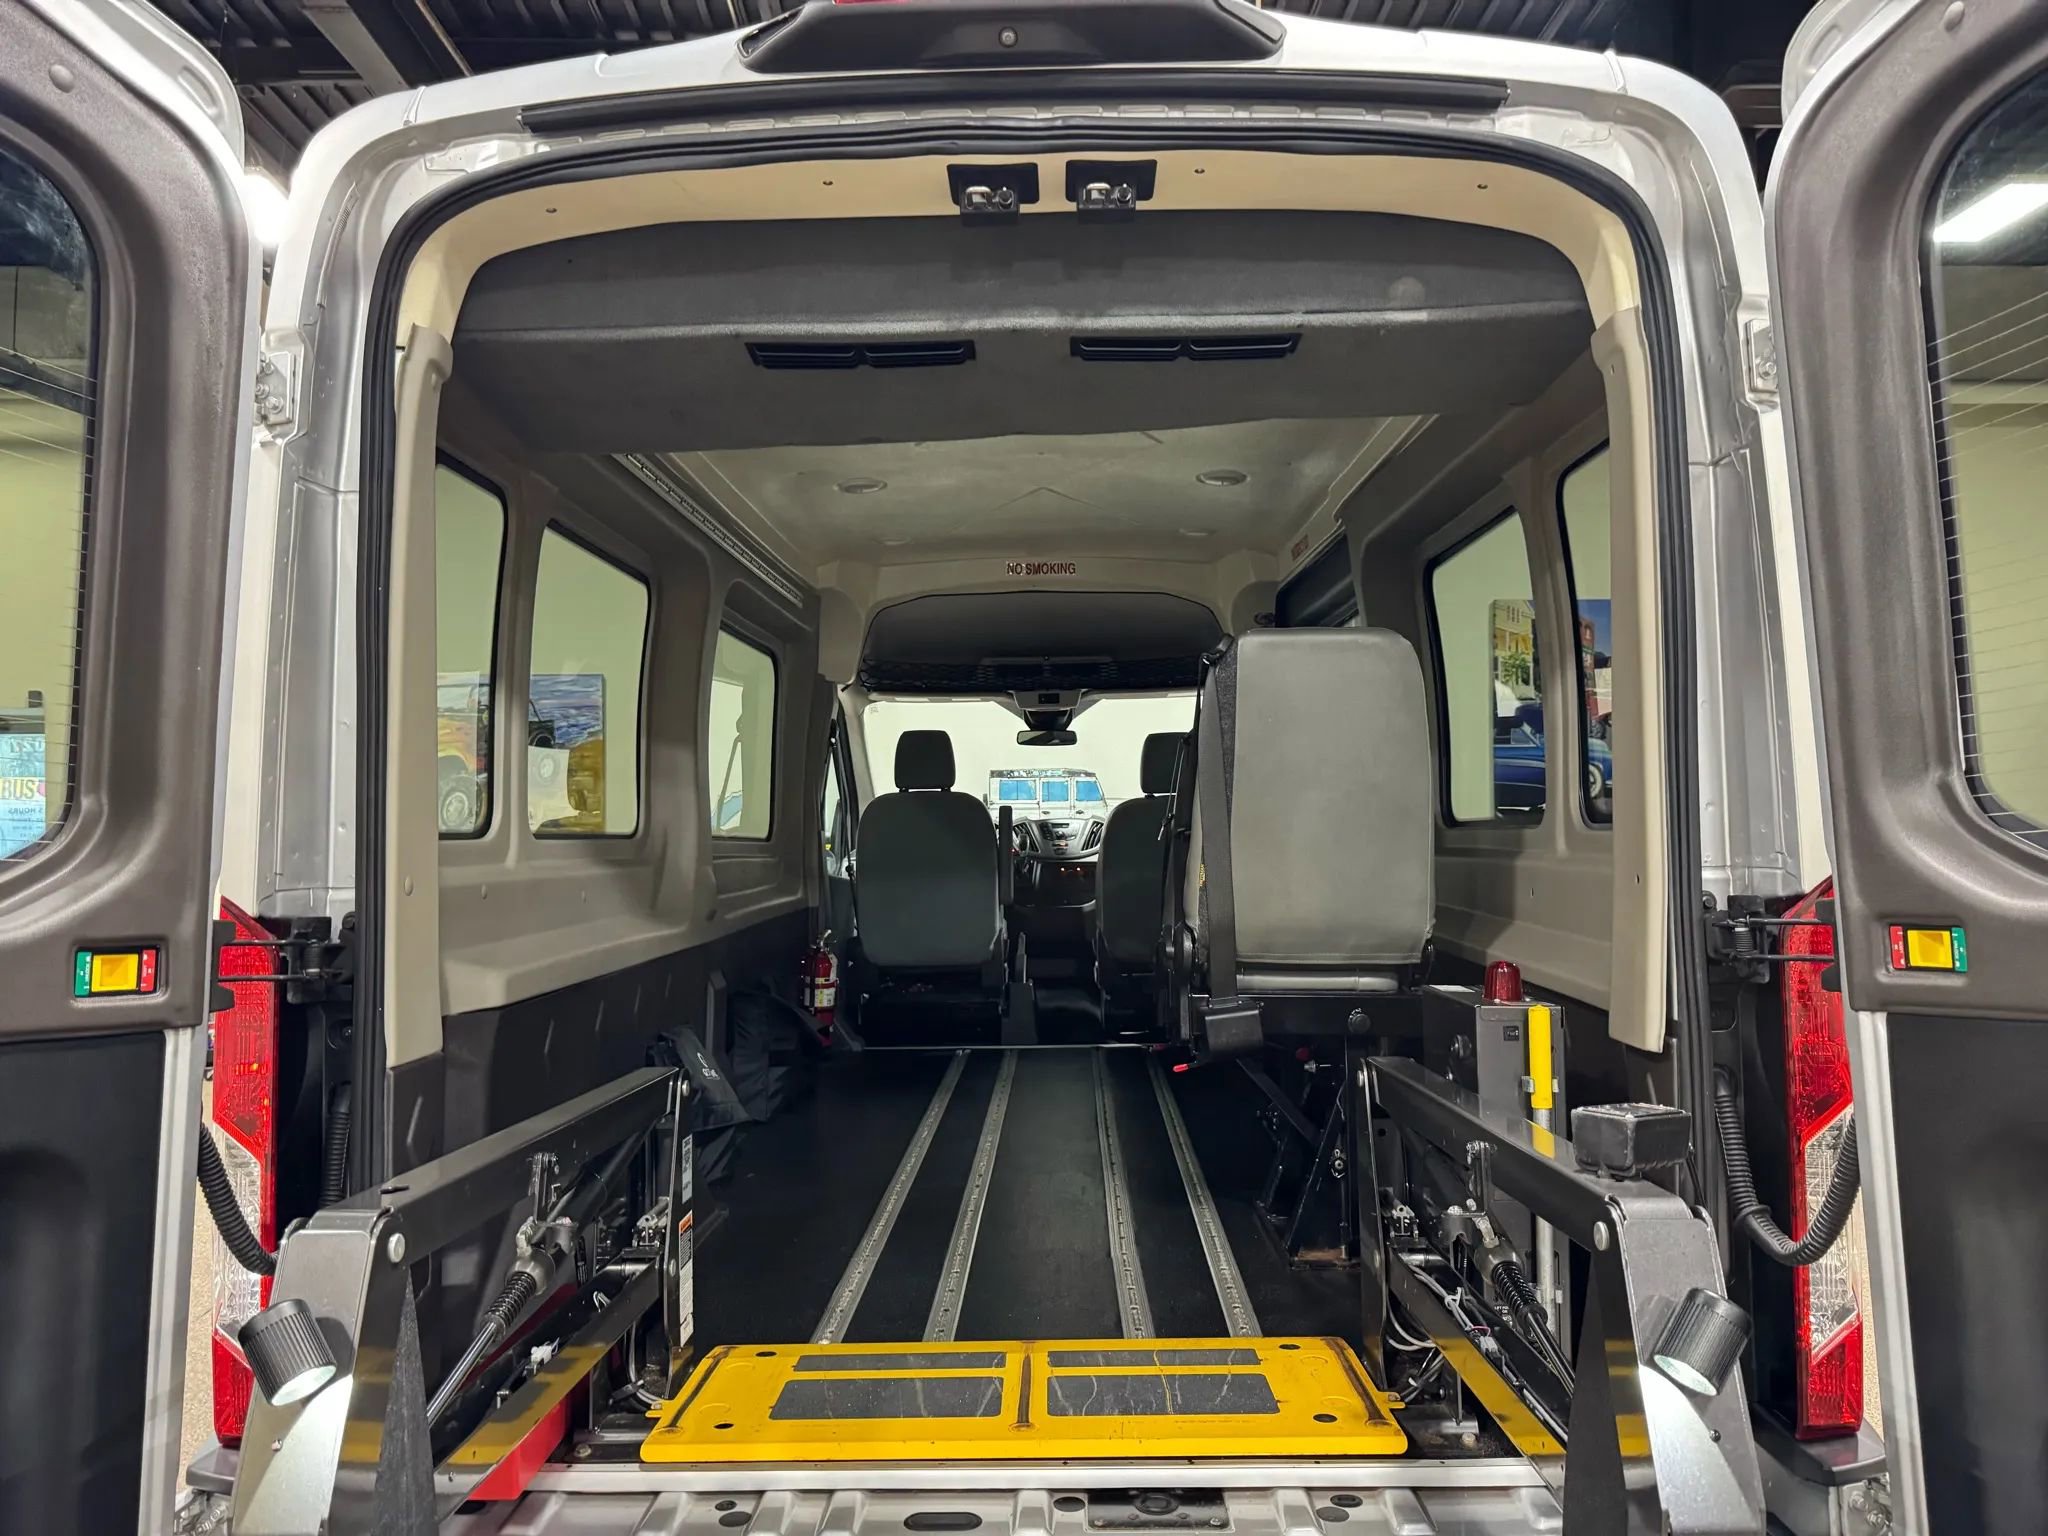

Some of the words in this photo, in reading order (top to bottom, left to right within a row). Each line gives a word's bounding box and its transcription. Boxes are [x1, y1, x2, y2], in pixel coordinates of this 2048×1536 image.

[1007, 563, 1023, 575] NO
[1025, 562, 1076, 575] SMOKING
[2, 779, 36, 800] BUS
